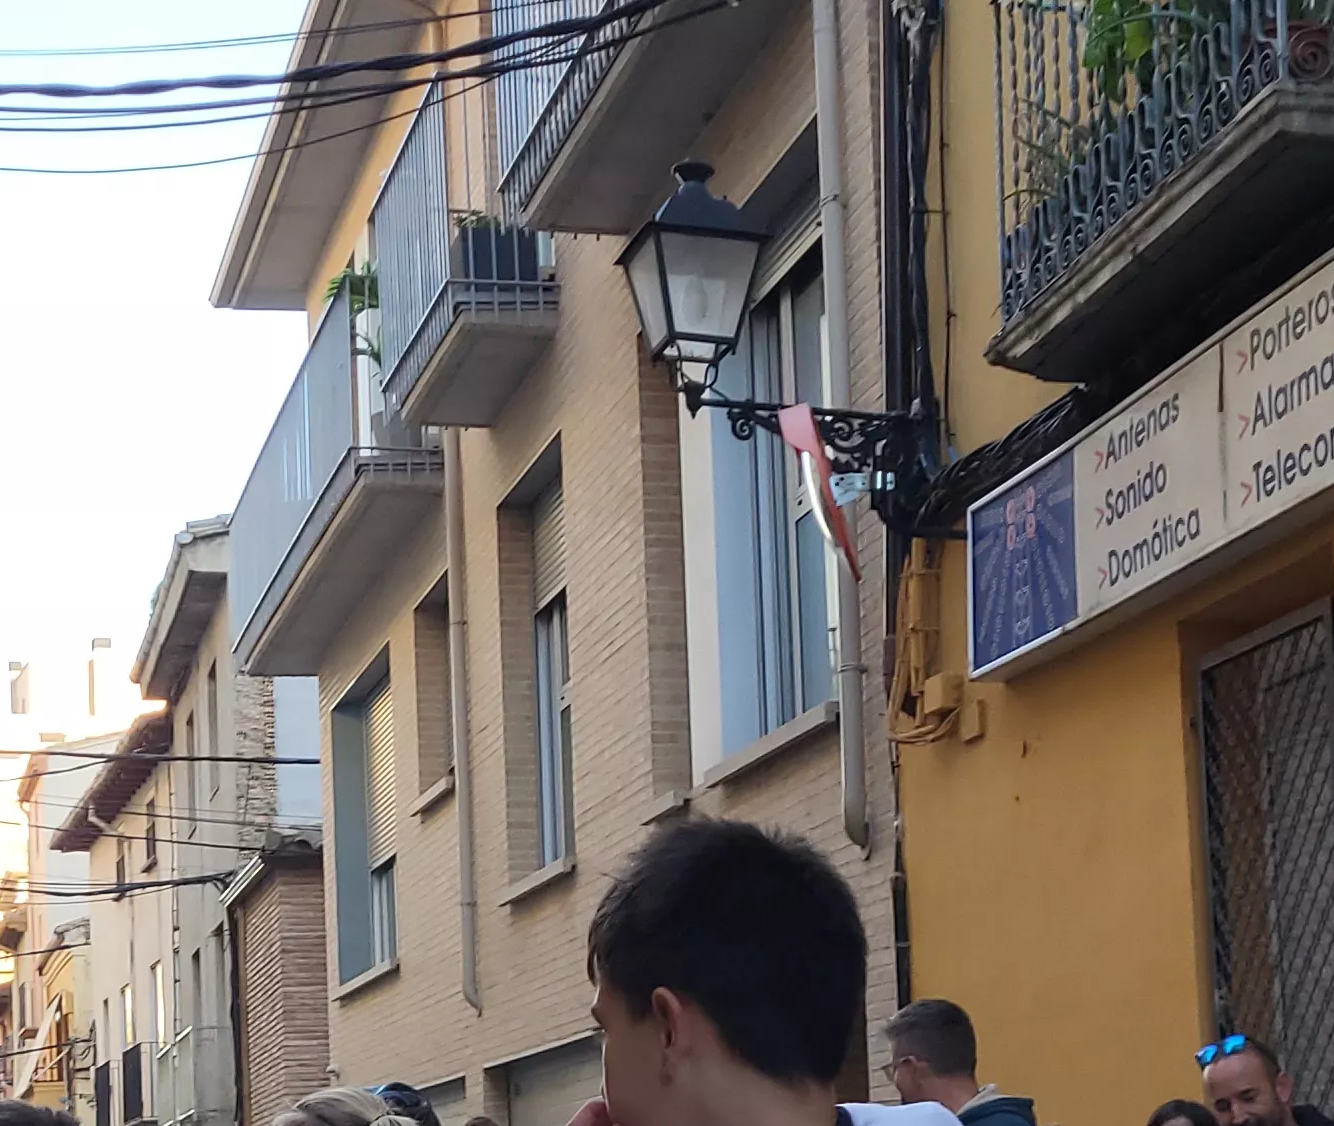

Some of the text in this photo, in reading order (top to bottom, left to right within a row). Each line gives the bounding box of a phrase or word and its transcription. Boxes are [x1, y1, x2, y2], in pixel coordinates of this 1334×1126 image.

[1104, 392, 1181, 470] Antenas
[1105, 460, 1168, 526] Sonido
[1107, 507, 1202, 588] Domótica
